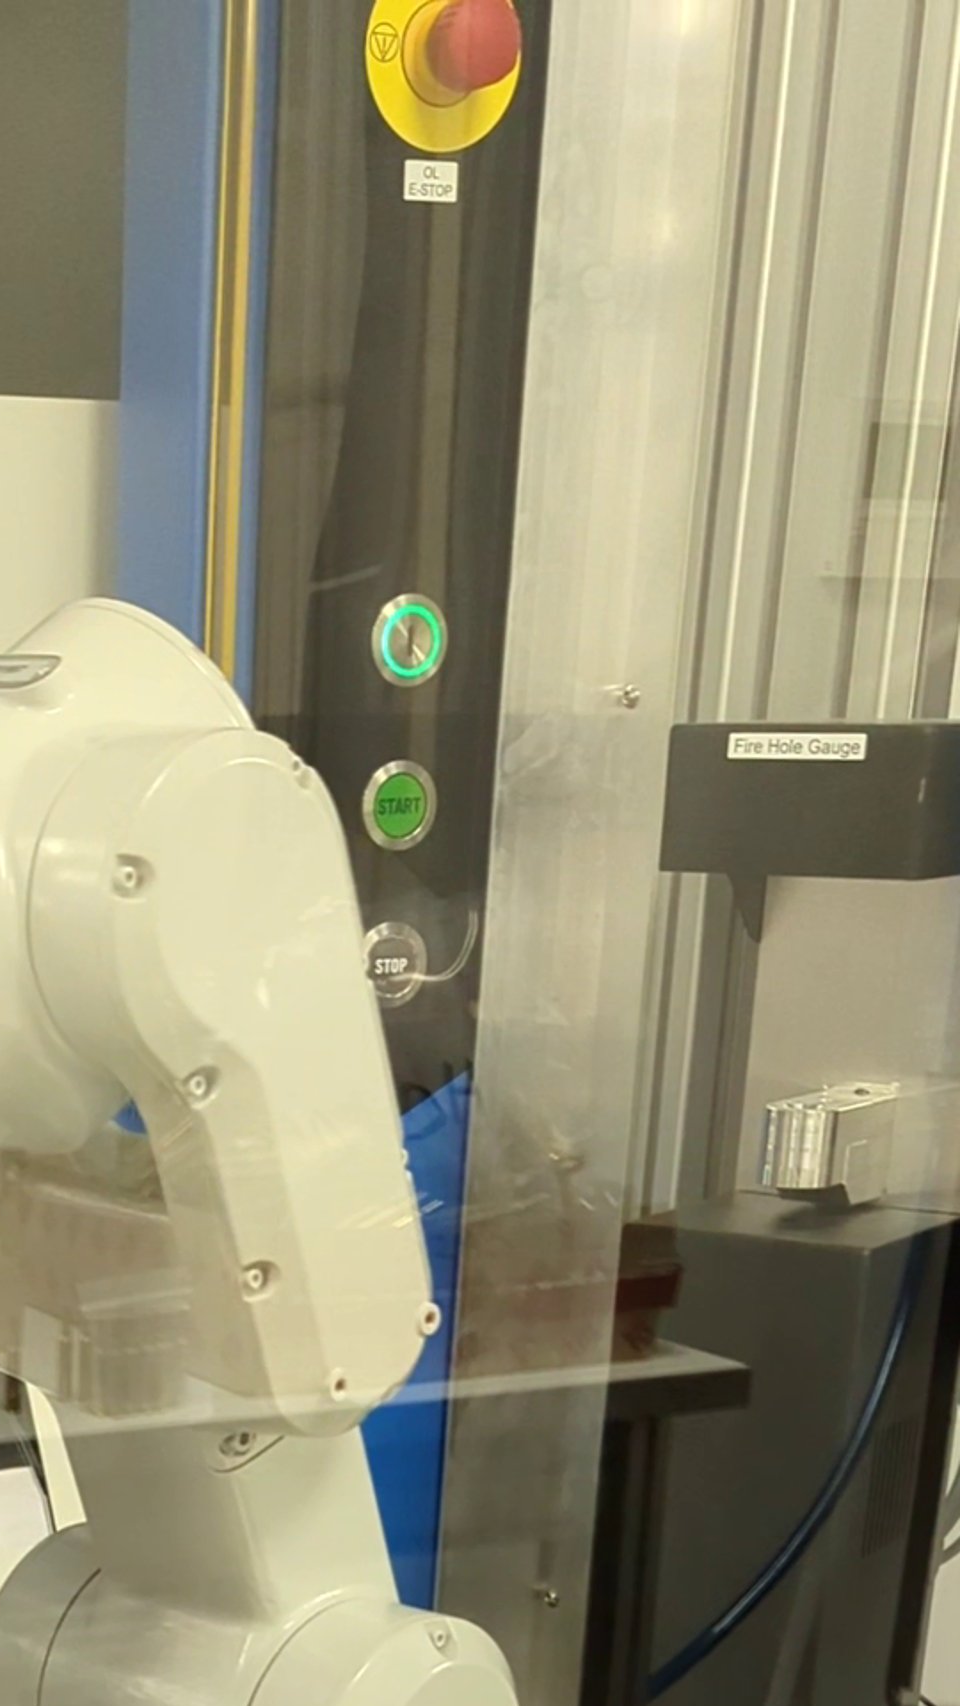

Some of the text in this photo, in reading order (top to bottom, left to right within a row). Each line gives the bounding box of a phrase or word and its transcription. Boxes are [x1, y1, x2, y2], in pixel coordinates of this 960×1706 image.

[423, 166, 439, 180] OL
[408, 183, 453, 197] E-STOP
[733, 738, 861, 758] Fire Hole Gauge
[378, 797, 421, 816] START
[374, 957, 408, 975] STOP
